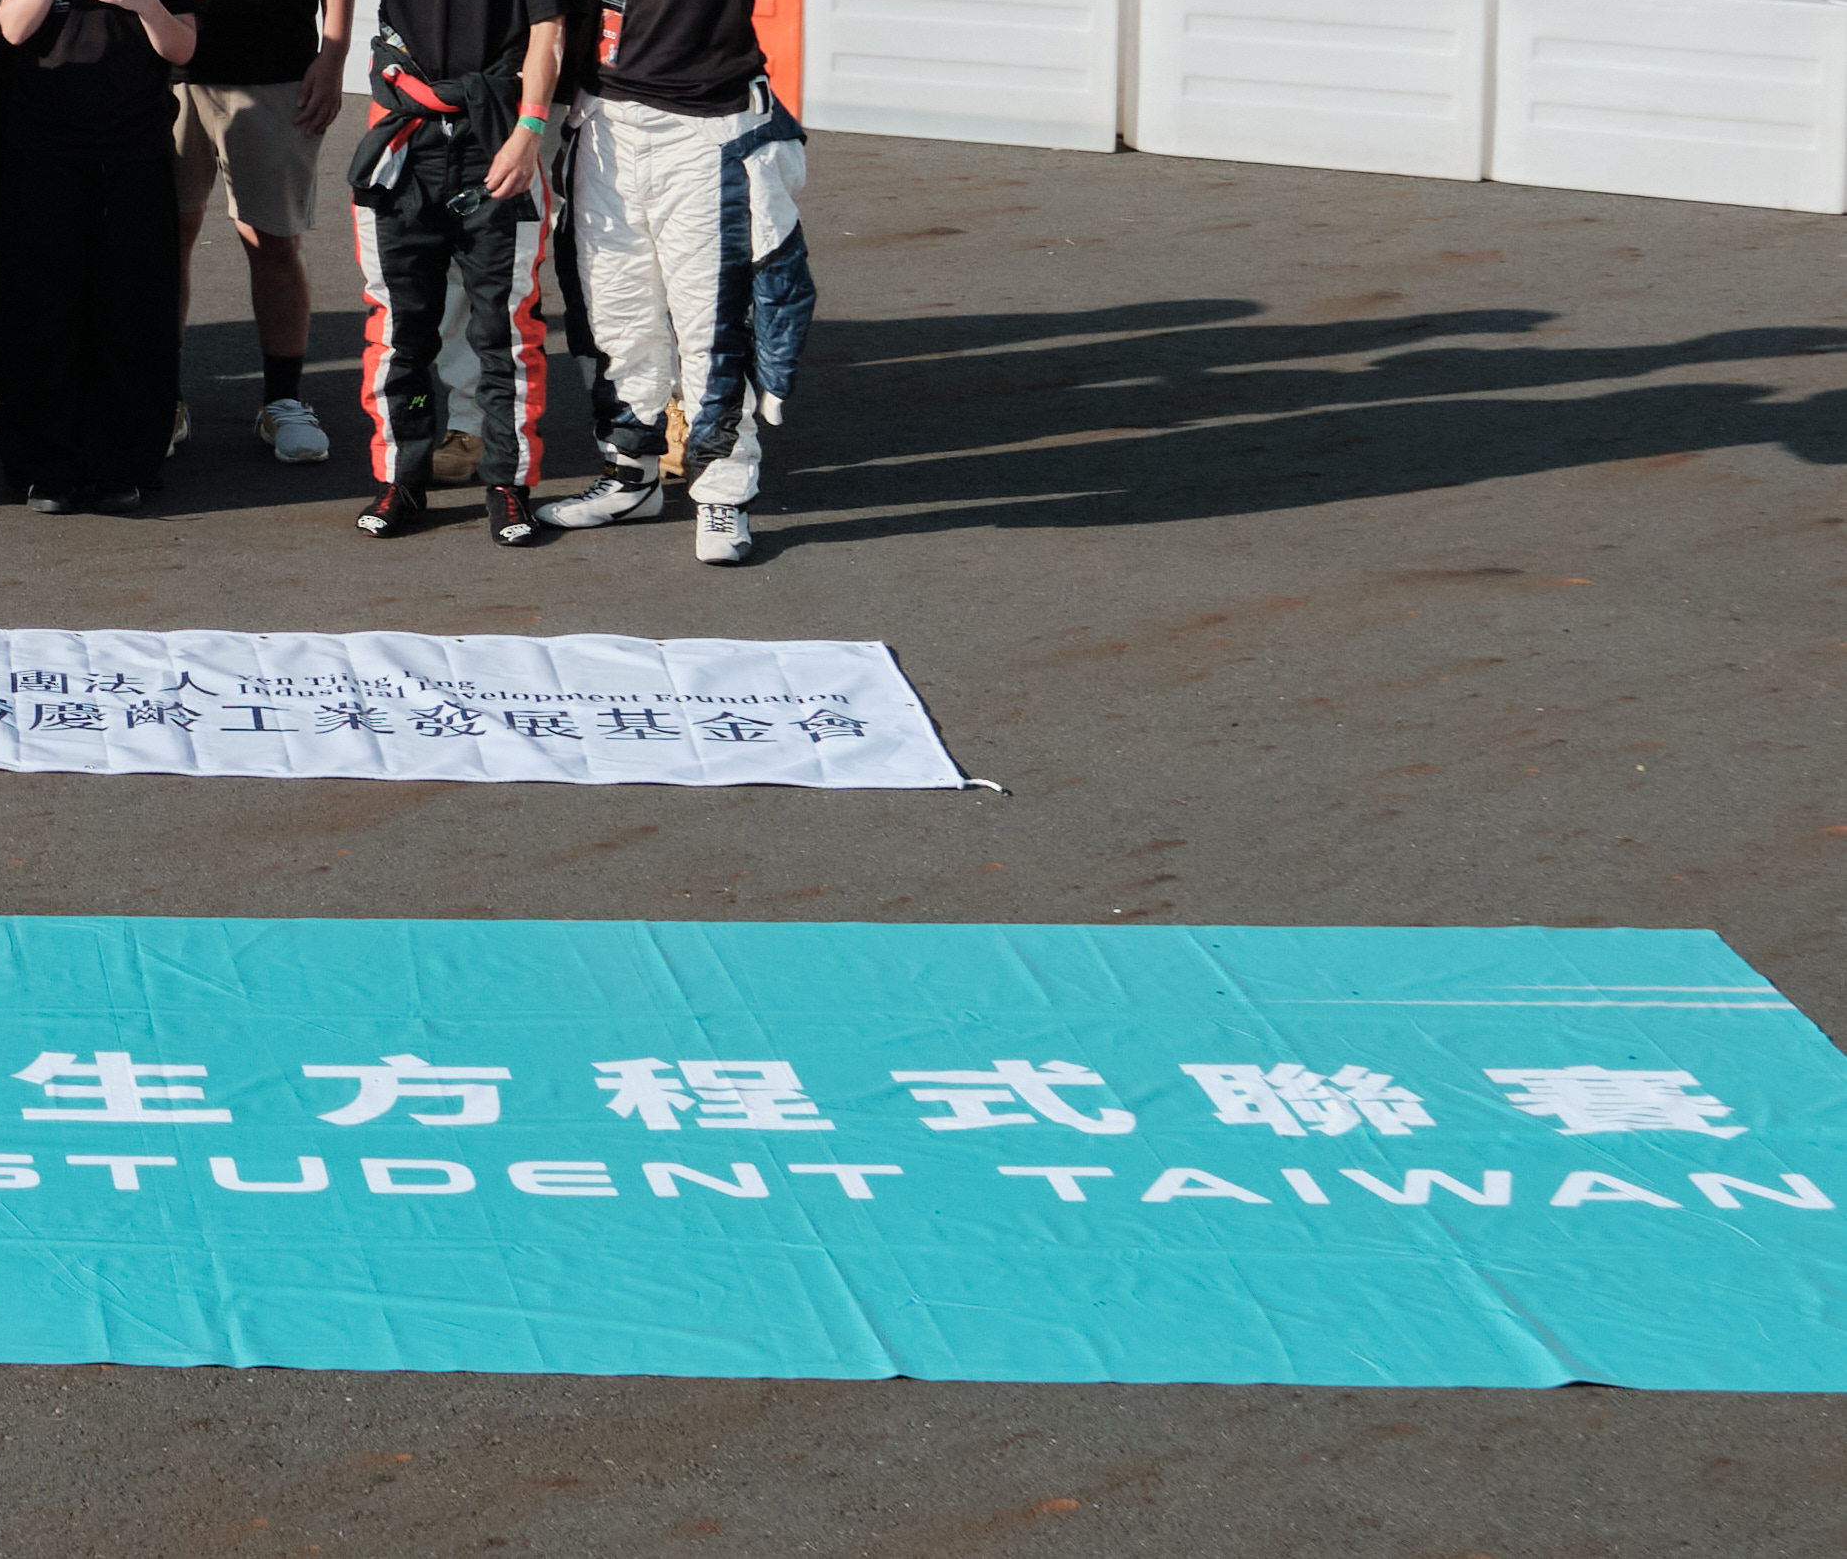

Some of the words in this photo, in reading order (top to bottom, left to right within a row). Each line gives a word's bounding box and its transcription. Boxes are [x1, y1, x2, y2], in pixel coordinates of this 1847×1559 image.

[458, 691, 643, 705] velopment
[656, 693, 851, 706] Foundation
[997, 1163, 1837, 1211] TAIWAN
